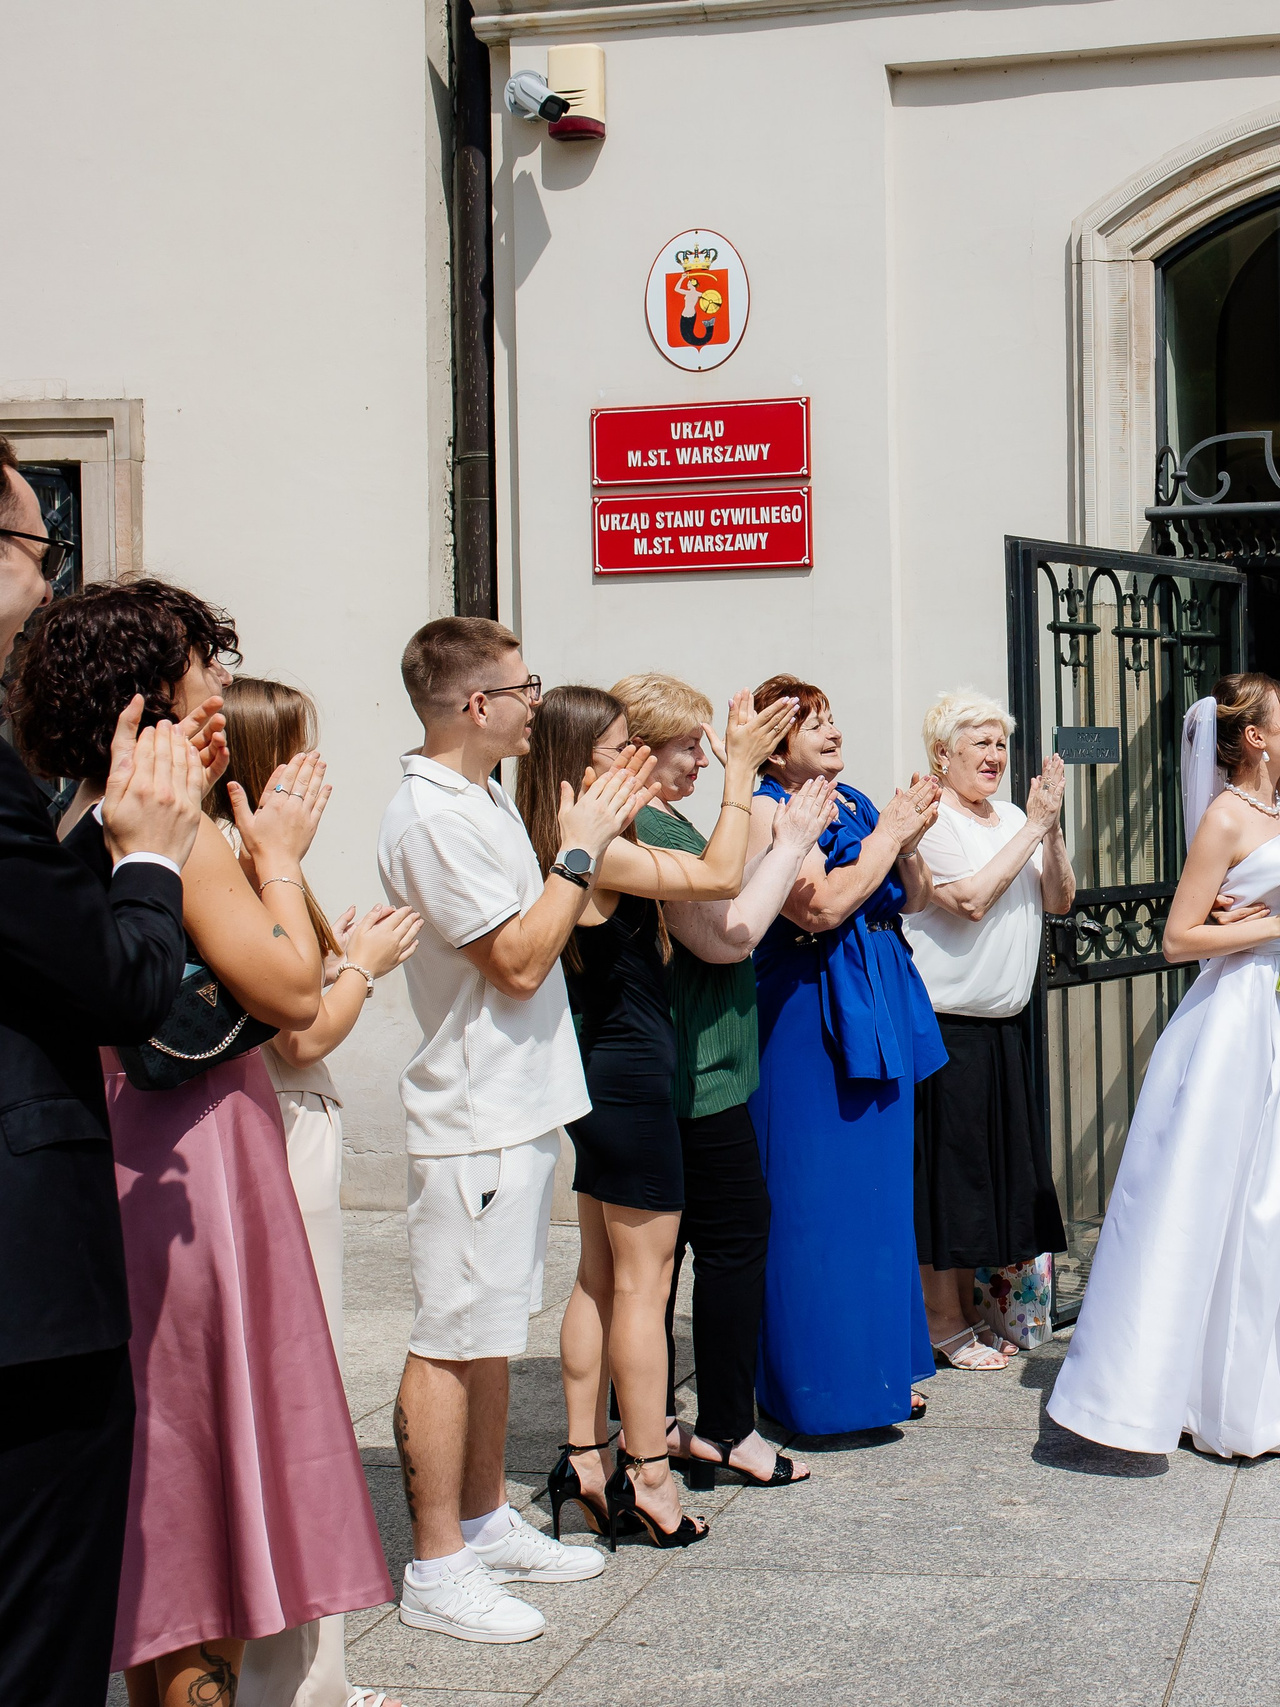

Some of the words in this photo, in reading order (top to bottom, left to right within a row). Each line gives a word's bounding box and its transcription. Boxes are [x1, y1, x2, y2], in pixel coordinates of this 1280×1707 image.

[670, 420, 725, 441] URZĄD
[627, 450, 671, 467] M.ST.
[676, 443, 771, 464] WARSZAWY
[600, 513, 650, 534] URZĄD
[655, 509, 705, 528] STANU
[710, 504, 803, 525] CYWILNEGO
[633, 537, 675, 555] M.ST.
[679, 532, 769, 552] WARSZAWY
